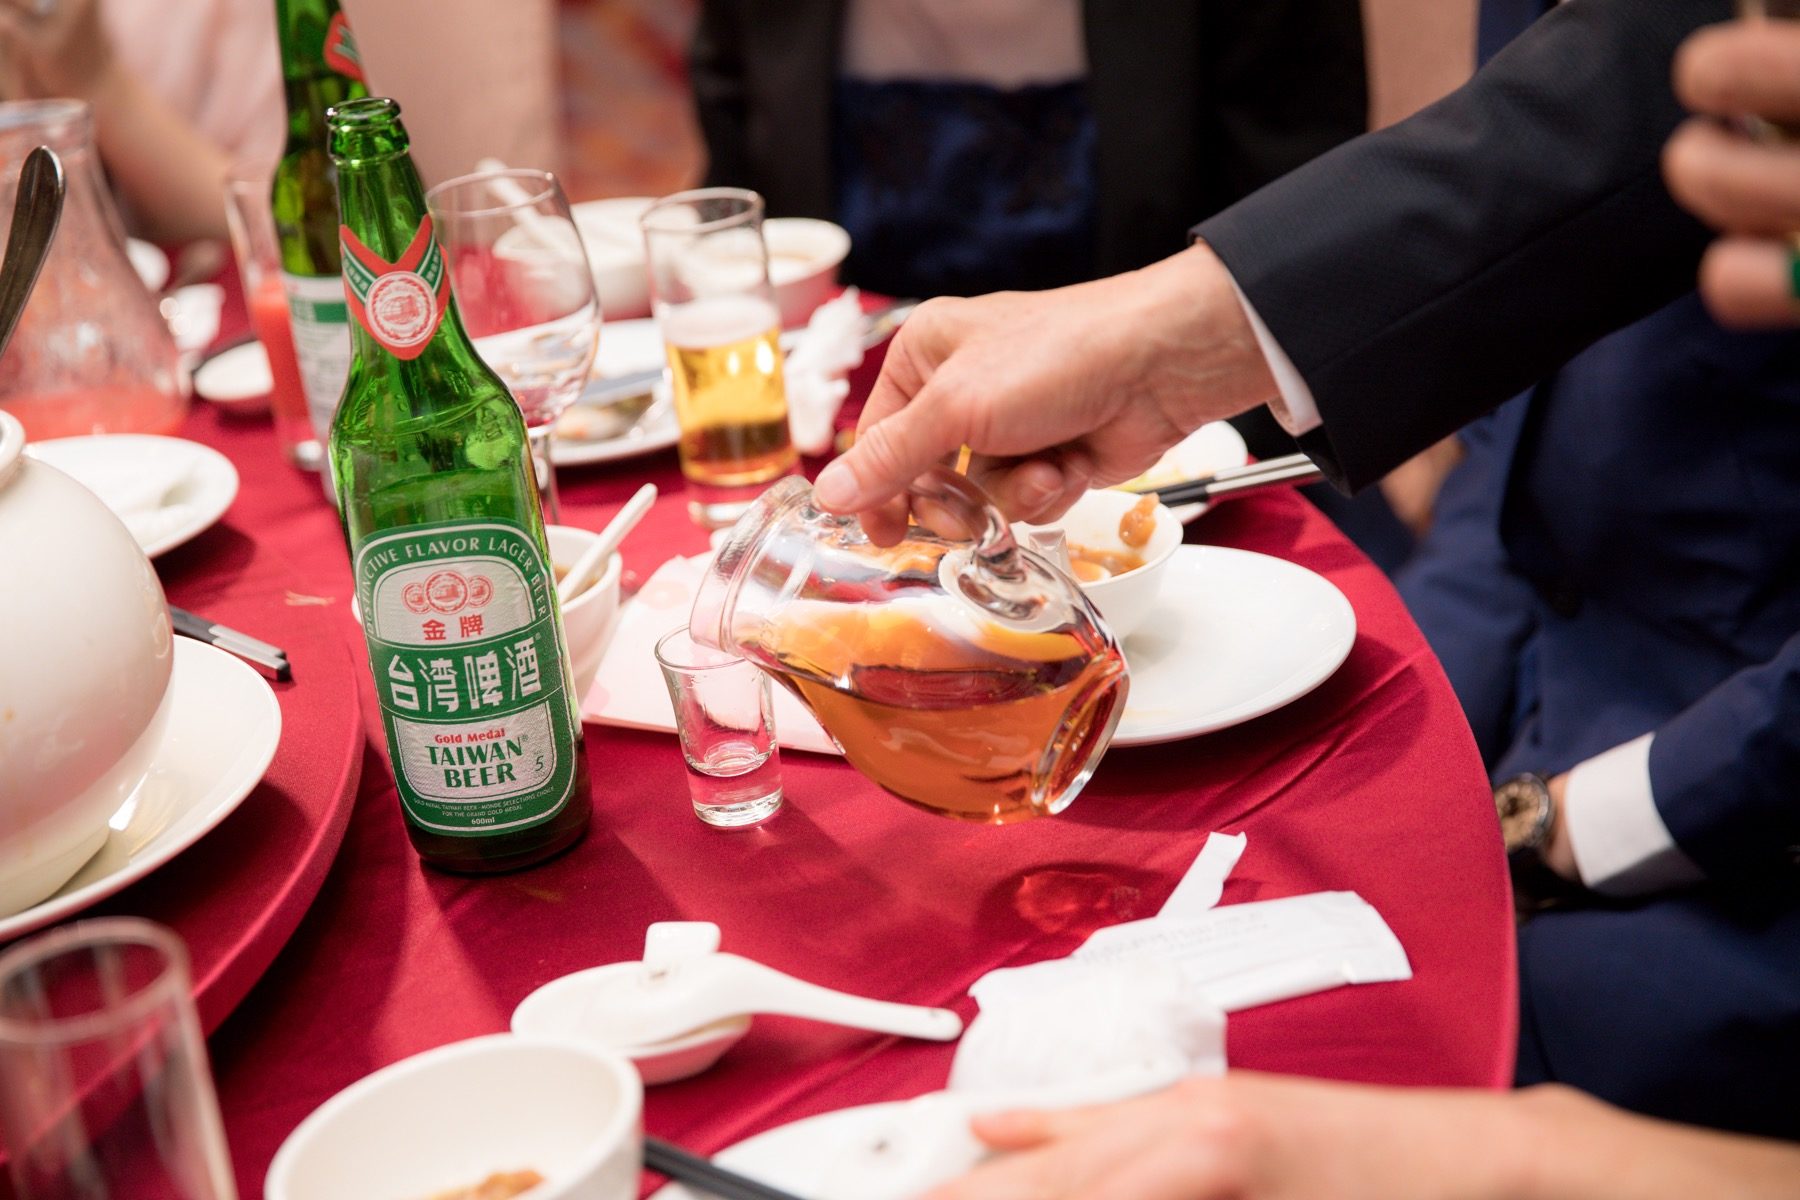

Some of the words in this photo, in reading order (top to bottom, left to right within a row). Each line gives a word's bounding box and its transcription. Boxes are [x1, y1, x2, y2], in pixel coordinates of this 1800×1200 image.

[405, 537, 479, 558] FLAVOR
[488, 537, 533, 571] LAGER
[531, 573, 547, 616] BEER
[422, 614, 484, 641] 金牌
[434, 734, 462, 744] Gold
[467, 728, 505, 742] Medal
[424, 737, 522, 766] TAIWAN
[534, 755, 544, 772] 5
[444, 762, 516, 788] BEER
[471, 817, 495, 825] 600ml
